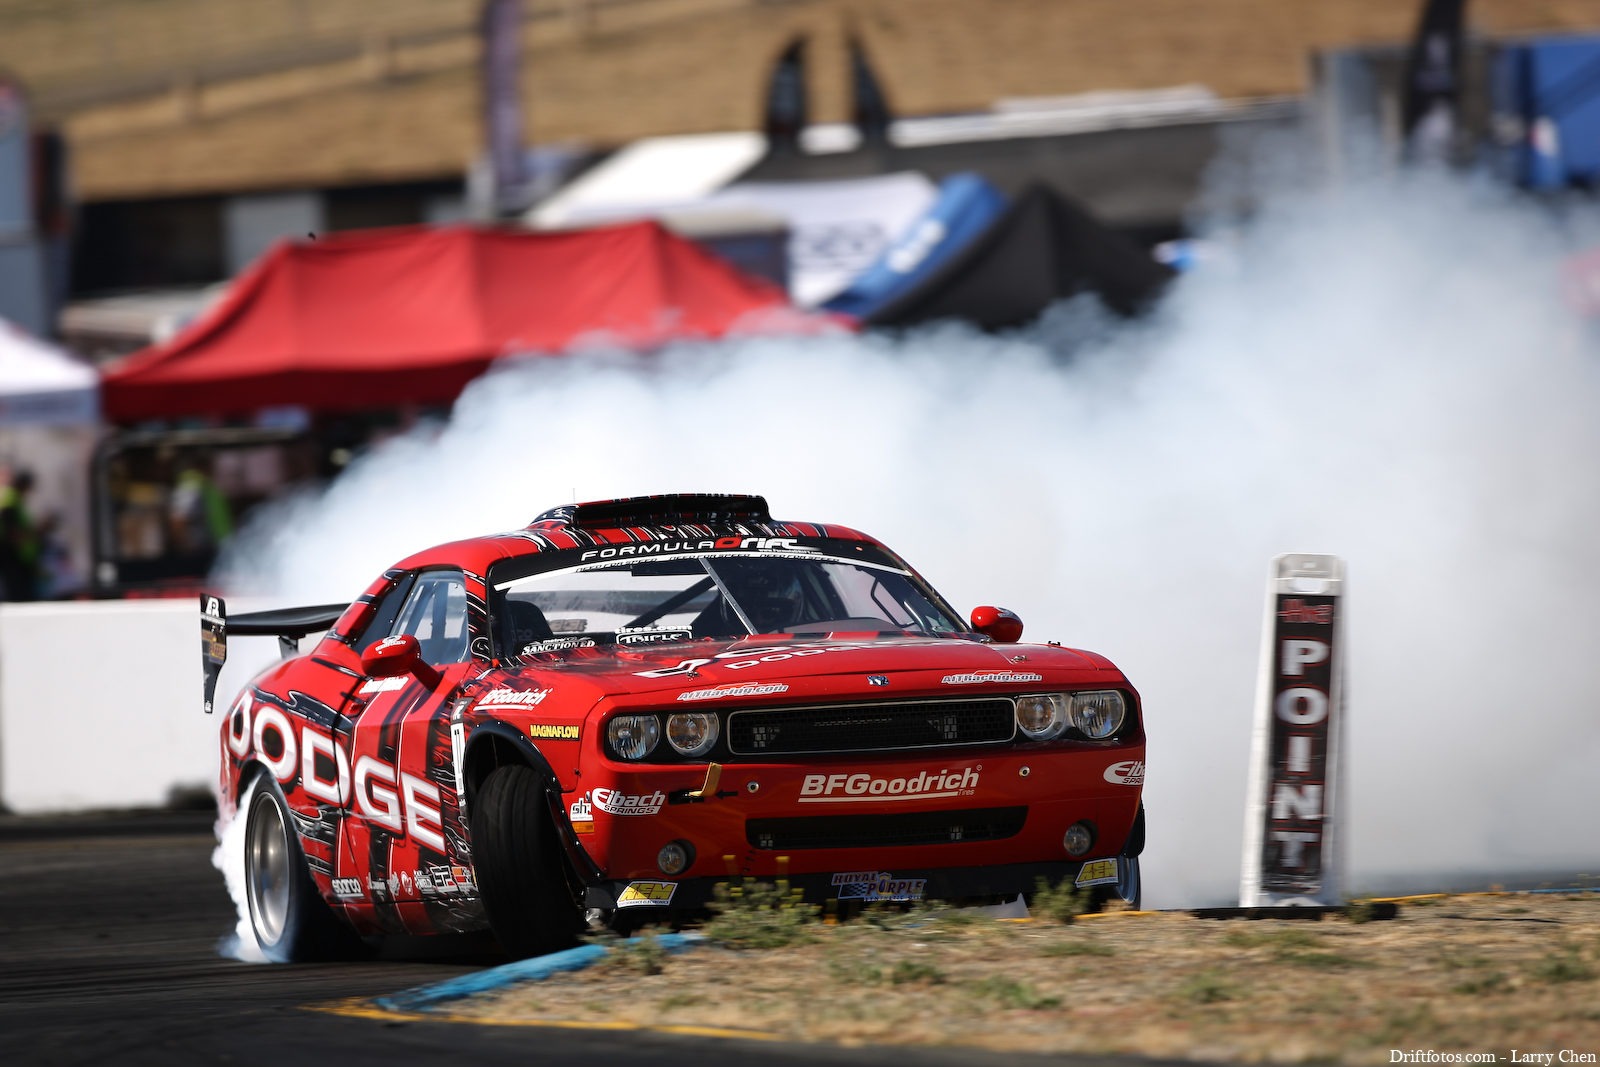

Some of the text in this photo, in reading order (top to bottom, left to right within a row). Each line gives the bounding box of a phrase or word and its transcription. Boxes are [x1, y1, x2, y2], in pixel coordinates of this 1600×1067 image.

[521, 639, 596, 656] SANCTIONED
[530, 724, 579, 739] MAGNAFLOW
[1270, 638, 1330, 869] POINT
[228, 690, 446, 853] DODGE
[799, 767, 980, 797] BFGoodrich
[592, 788, 666, 810] Eibach
[604, 804, 656, 815] SPRINGS
